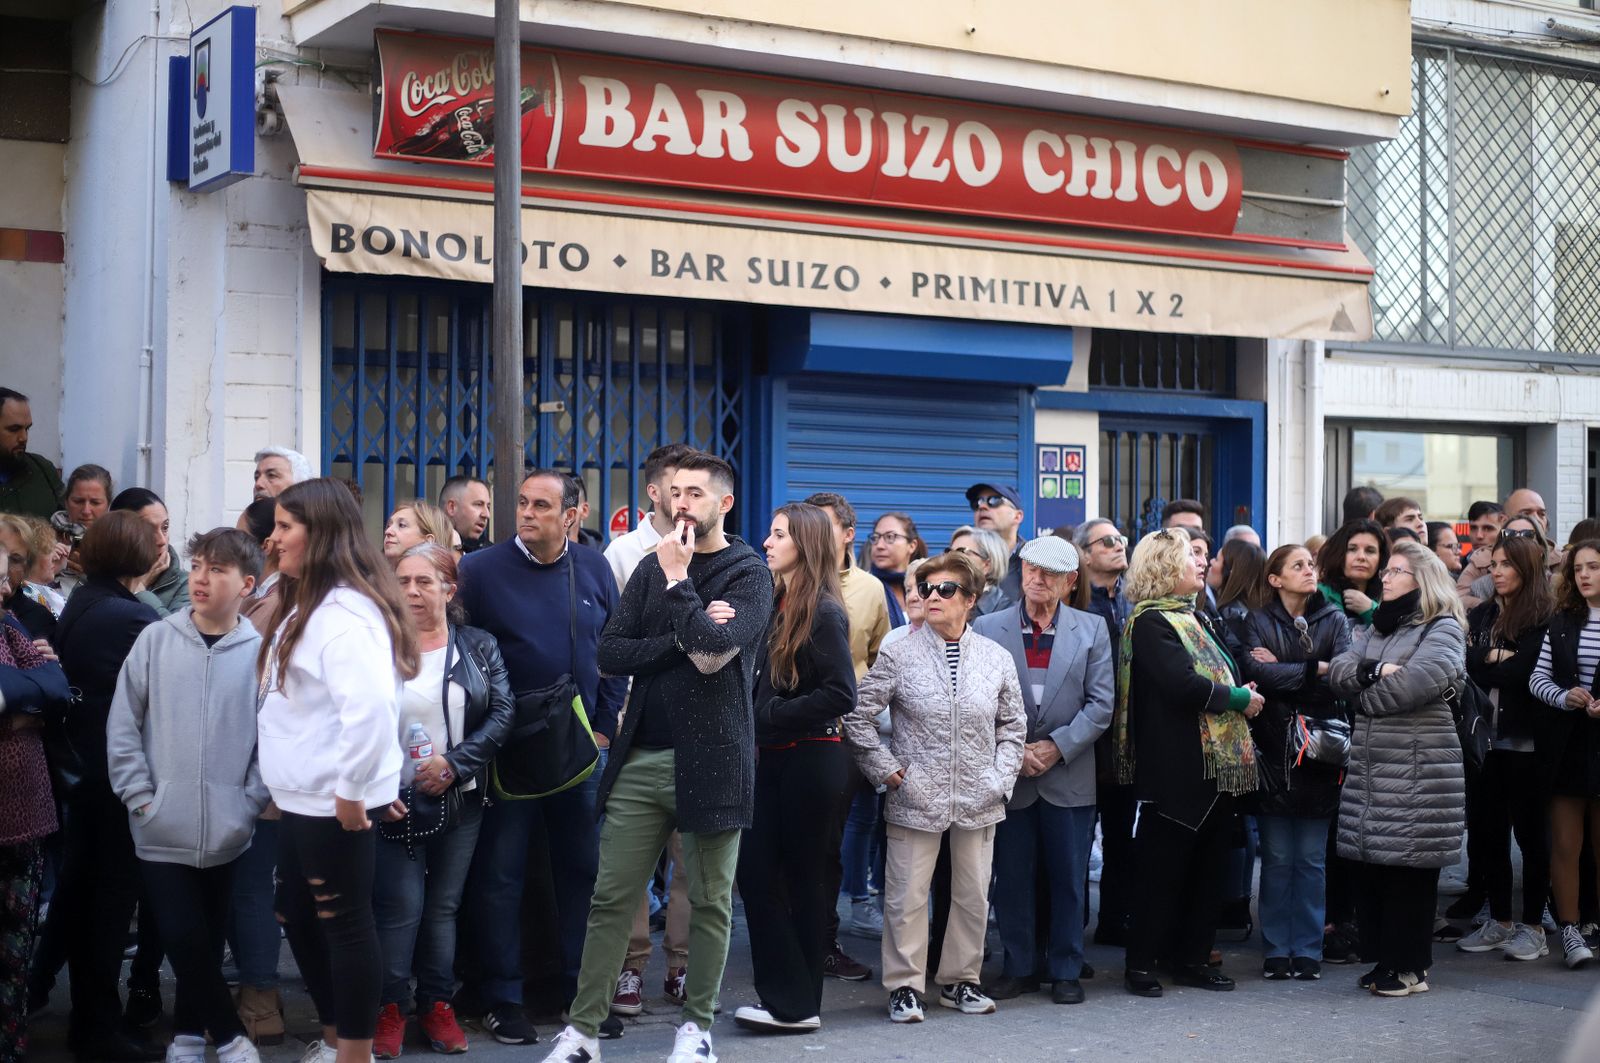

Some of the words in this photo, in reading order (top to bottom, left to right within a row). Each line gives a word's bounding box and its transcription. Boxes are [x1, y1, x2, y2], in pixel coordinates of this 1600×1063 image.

[578, 75, 753, 162] BAR
[775, 98, 1003, 187] SUIZO
[1022, 129, 1229, 212] CHICO
[330, 223, 590, 272] BONOLTO
[650, 249, 728, 282] BAR
[747, 257, 860, 292] SUIZO
[911, 272, 1090, 311] PRIMITIVA
[1108, 289, 1116, 313] 1
[1136, 290, 1156, 316] X
[1169, 294, 1184, 318] 2
